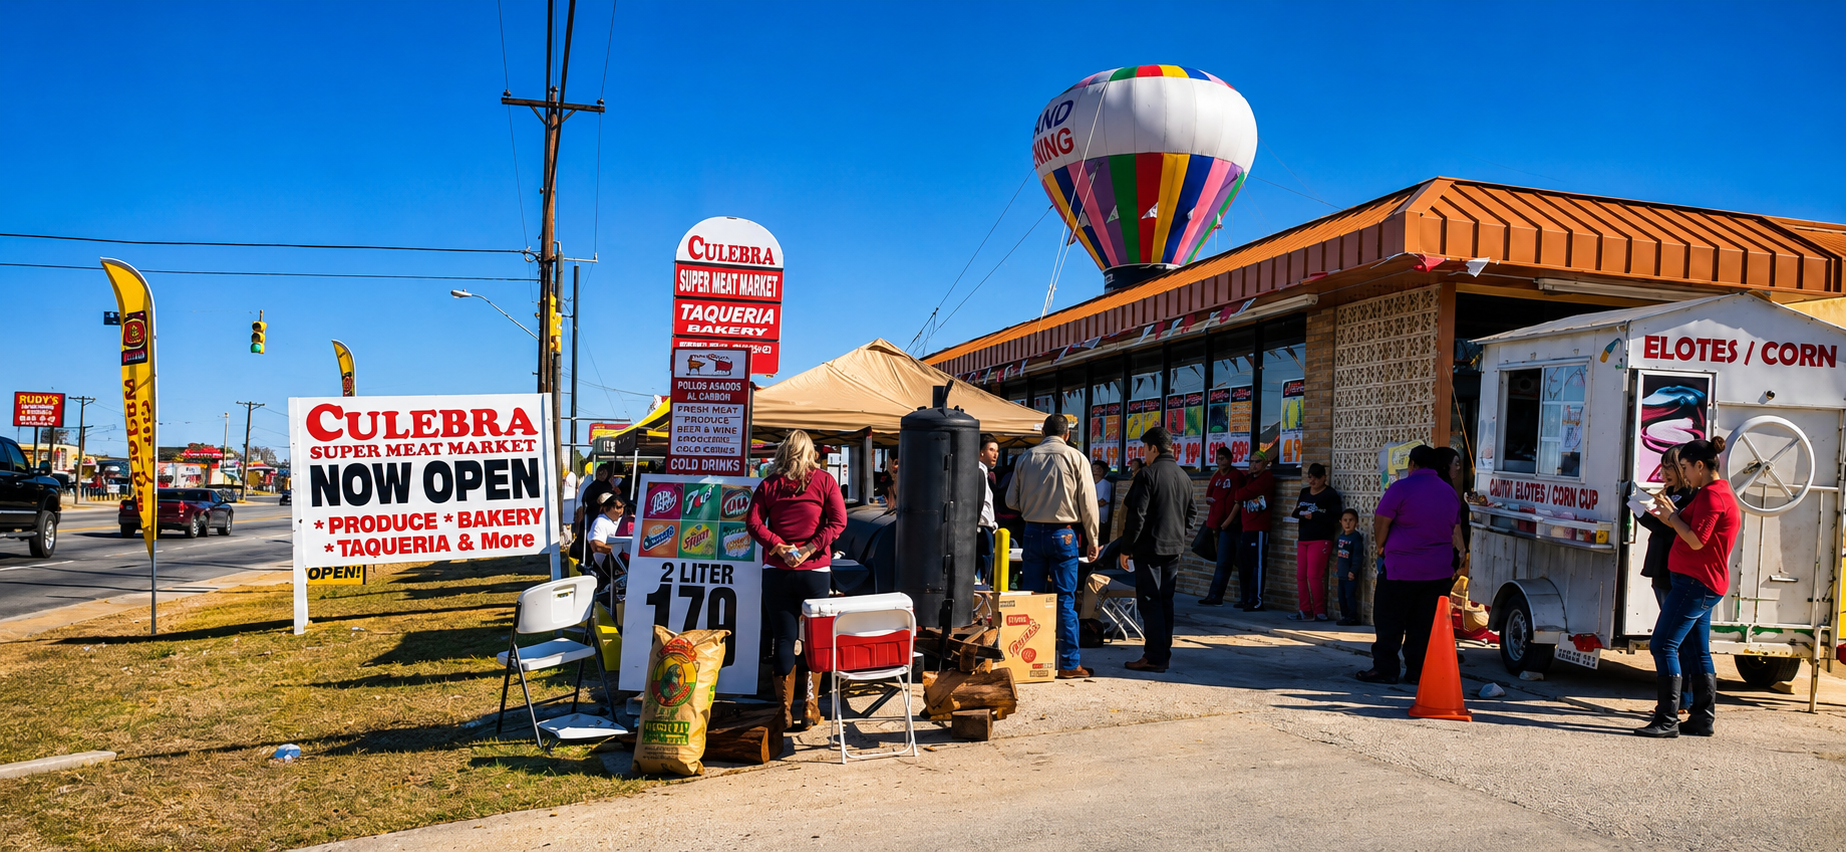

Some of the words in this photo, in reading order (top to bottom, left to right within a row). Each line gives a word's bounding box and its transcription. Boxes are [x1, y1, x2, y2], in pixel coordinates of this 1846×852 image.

[688, 235, 775, 265] CULEBRA
[679, 269, 710, 293] SUPER
[712, 271, 738, 295] MEAT
[739, 274, 778, 298] MARKET
[681, 303, 775, 325] TAQUERIA
[686, 324, 768, 336] BAKERY
[1643, 335, 1738, 363] ELOTES
[1761, 341, 1837, 368] CORN
[677, 381, 707, 390] POLLOS
[19, 395, 59, 405] RUDY'S
[687, 392, 697, 401] AL
[684, 416, 730, 424] PRODUCE
[712, 406, 738, 414] MEAT
[306, 403, 539, 442] CULEBRA
[712, 426, 738, 434] WINE
[310, 444, 381, 459] SUPER
[385, 442, 443, 458] MEAT
[448, 439, 537, 455] MARKET
[671, 458, 698, 470] COLD
[310, 462, 412, 507] NOW
[422, 458, 541, 504] OPEN
[1515, 481, 1546, 504] ELOTES
[1552, 485, 1577, 507] CORN
[1578, 488, 1599, 510] CUP
[328, 512, 438, 535] PRODUCE
[457, 507, 544, 529] BAKERY
[337, 534, 451, 558] TAQUERIA
[457, 533, 475, 551] &
[481, 531, 535, 550] More
[308, 566, 361, 580] OPEN!
[660, 562, 674, 583] 2
[679, 562, 734, 584] LITER
